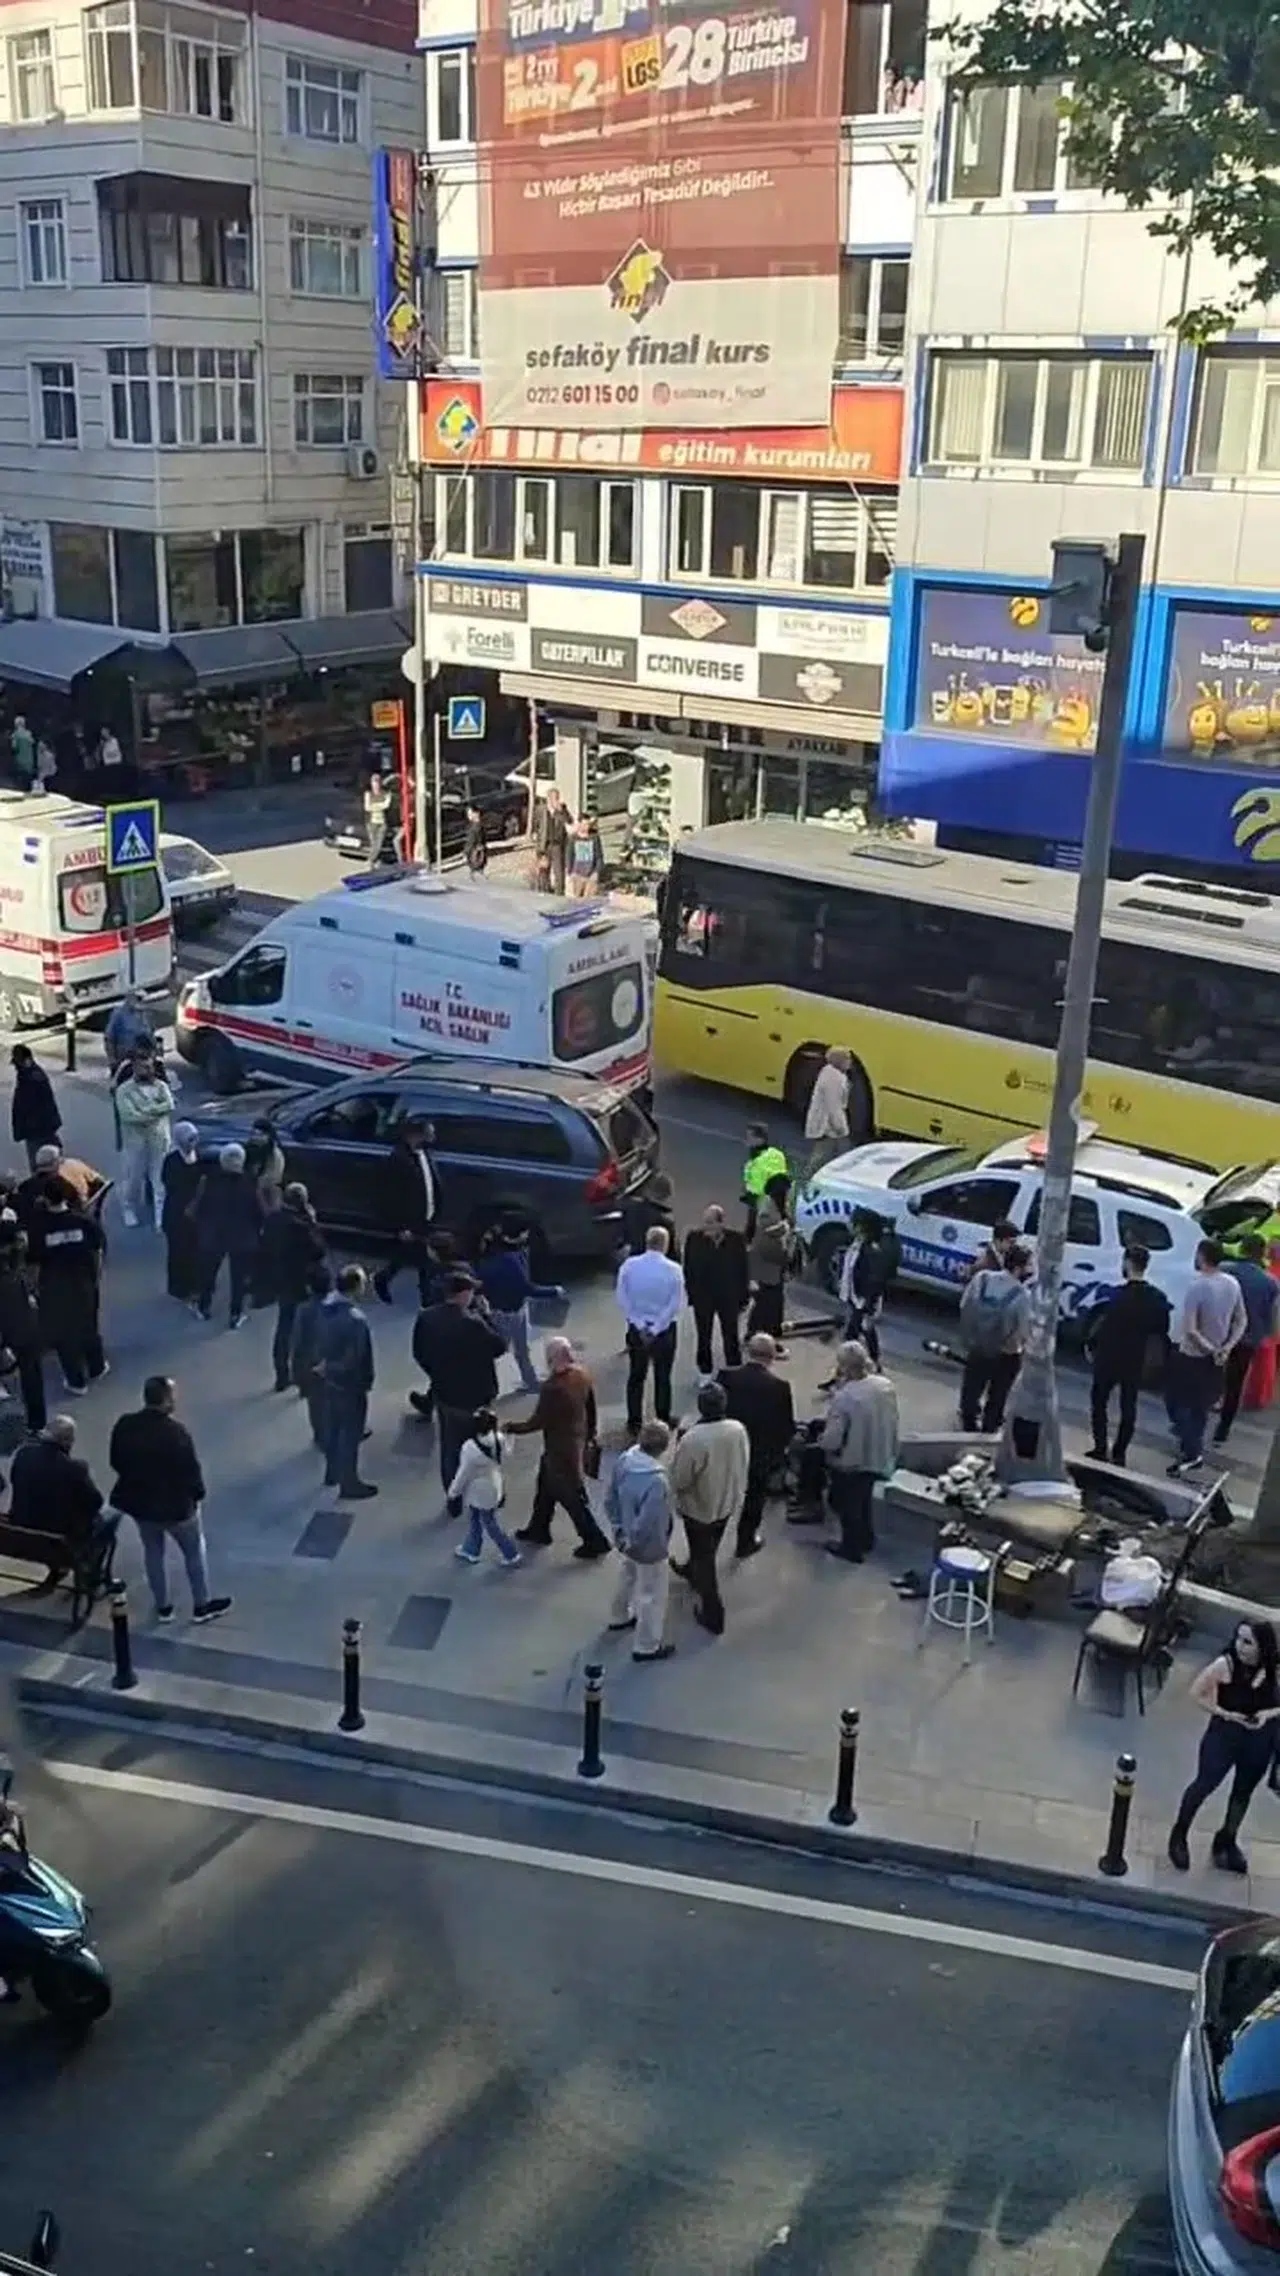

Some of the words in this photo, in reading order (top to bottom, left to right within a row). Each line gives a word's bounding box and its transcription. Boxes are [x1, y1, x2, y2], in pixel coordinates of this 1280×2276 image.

[728, 16, 798, 50] Türkiye
[658, 19, 727, 91] 28
[627, 57, 660, 89] LGS
[643, 181, 699, 204] Tesadüf
[525, 341, 620, 372] sefaköy
[626, 334, 701, 366] final
[705, 339, 770, 365] kurs
[526, 386, 559, 403] 0212
[562, 385, 591, 403] 601
[595, 385, 612, 403] 15
[615, 385, 638, 403] 00
[658, 440, 736, 467] eğitim
[744, 442, 871, 471] kurumları
[453, 583, 521, 611] GREYDER
[466, 626, 515, 649] Forelli
[540, 640, 626, 669] CATERPILLAR
[646, 653, 745, 683] CONVERSE
[1001, 648, 1053, 668] bağlan
[1201, 651, 1250, 670] bağlan
[401, 991, 441, 1014] SAĞLIK
[447, 1001, 511, 1030] BAKANLIĞI
